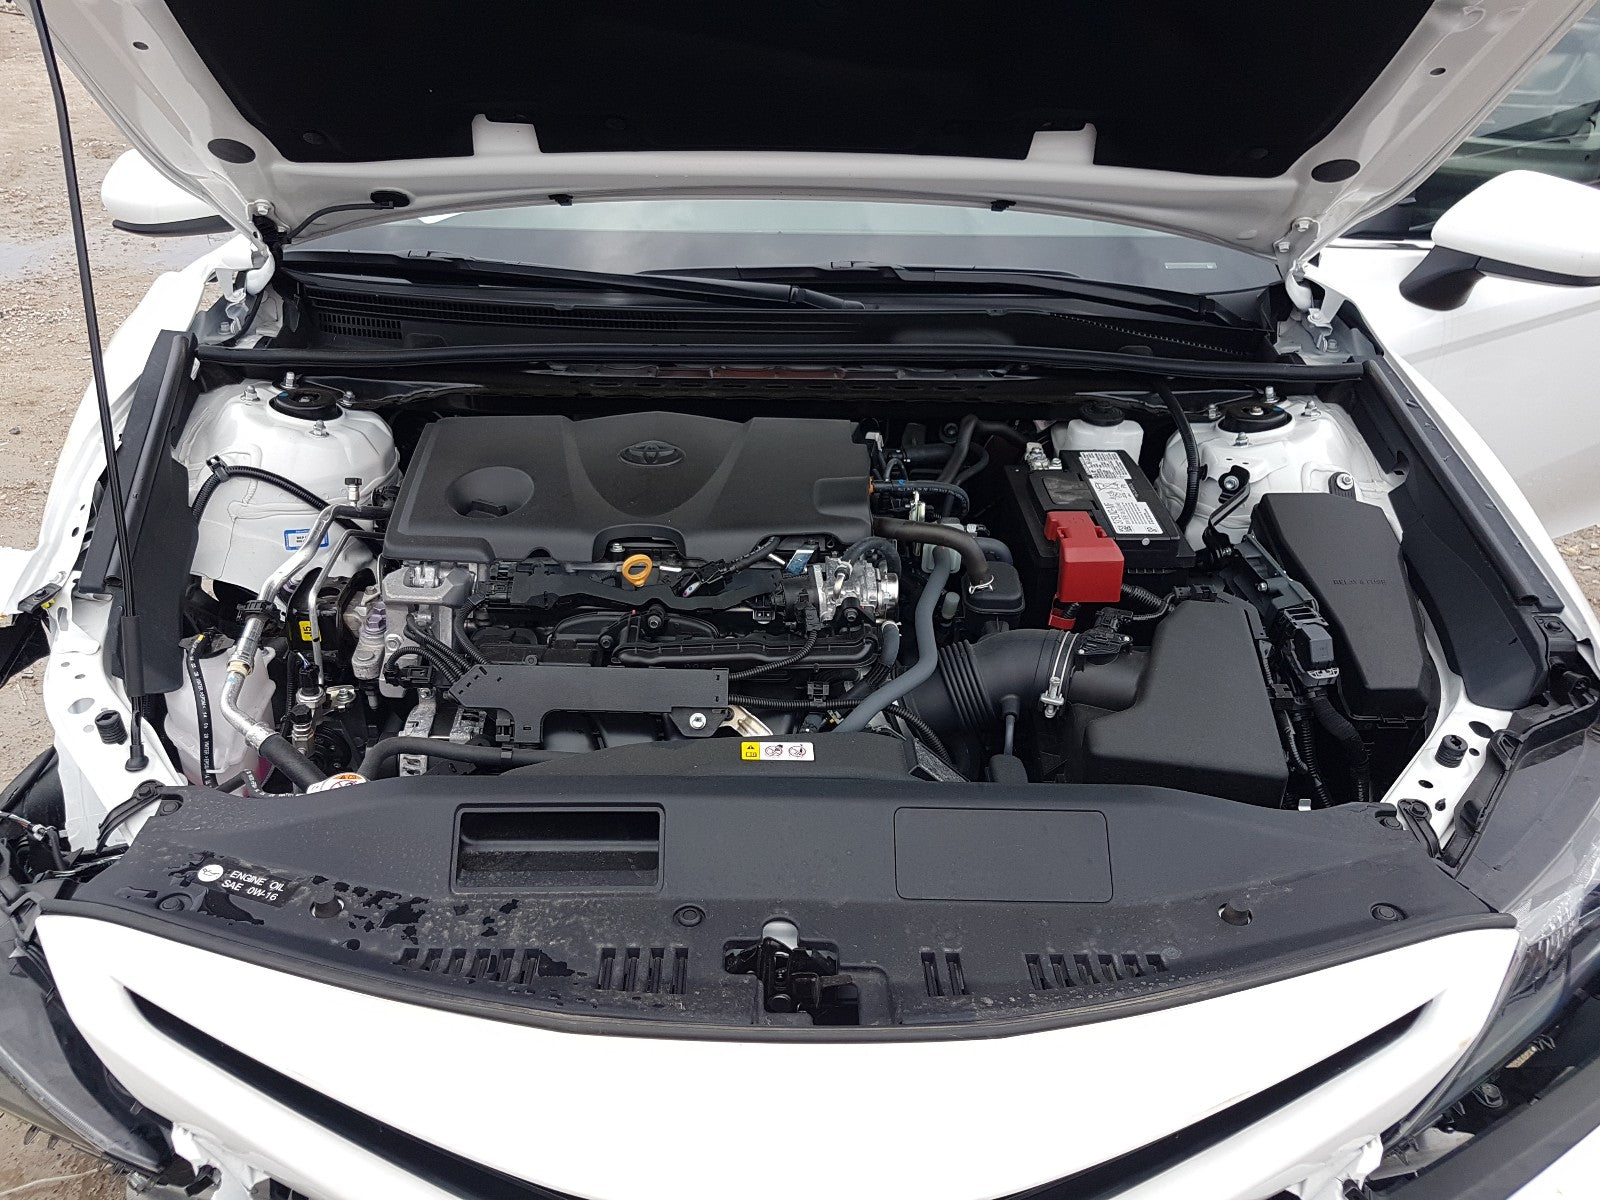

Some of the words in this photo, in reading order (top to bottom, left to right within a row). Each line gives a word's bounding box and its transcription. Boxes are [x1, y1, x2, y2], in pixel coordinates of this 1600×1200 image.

[222, 879, 244, 891] SAE
[247, 886, 278, 900] 0W-16
[230, 870, 267, 886] ENGINE
[270, 882, 284, 892] OIL
